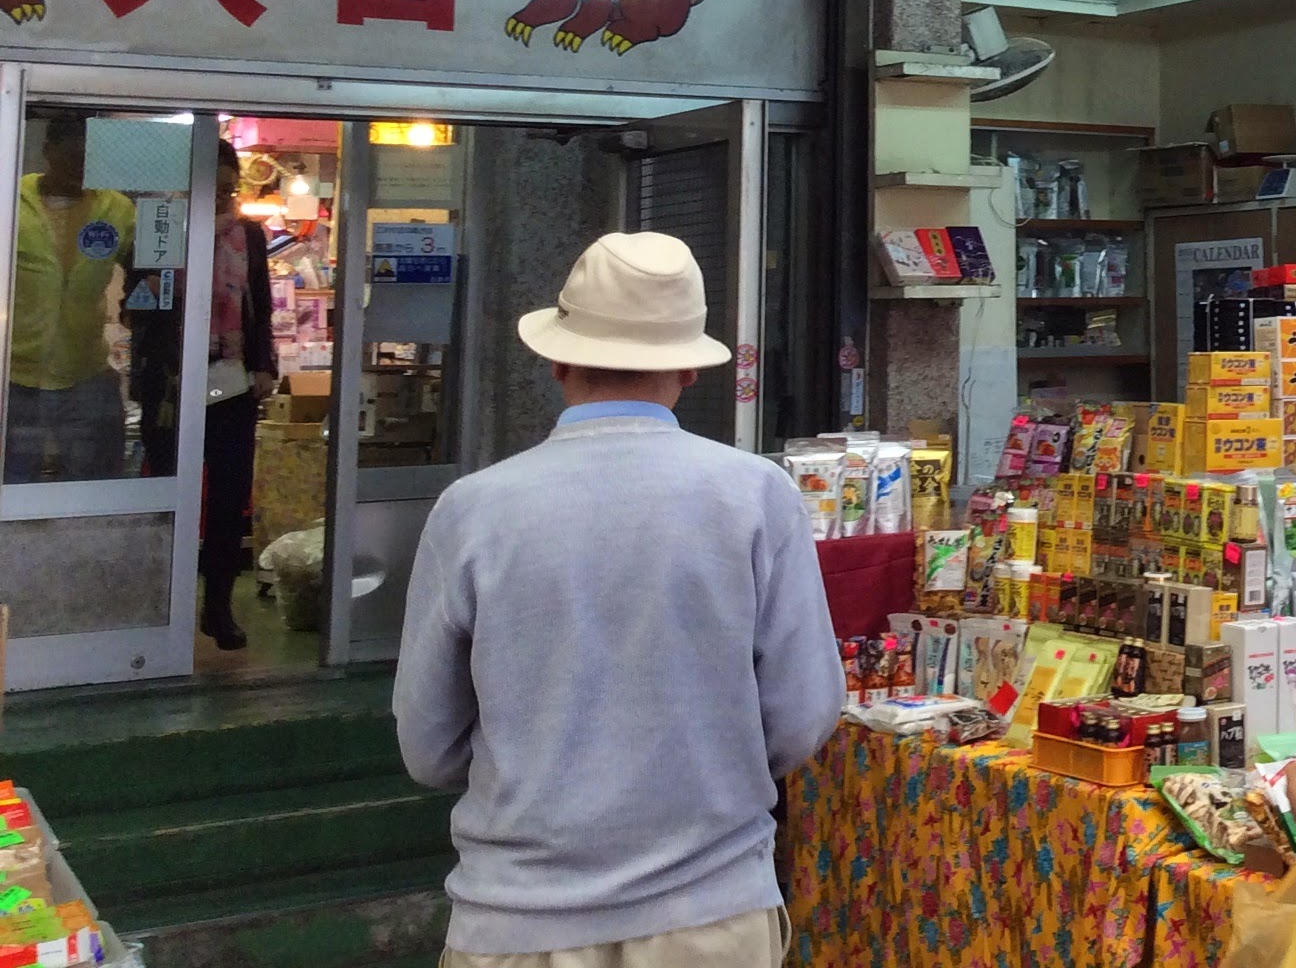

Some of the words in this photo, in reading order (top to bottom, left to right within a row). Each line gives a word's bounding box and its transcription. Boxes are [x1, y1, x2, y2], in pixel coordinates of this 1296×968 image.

[154, 204, 170, 263] 自動ドア
[1193, 244, 1260, 262] CALENDAR
